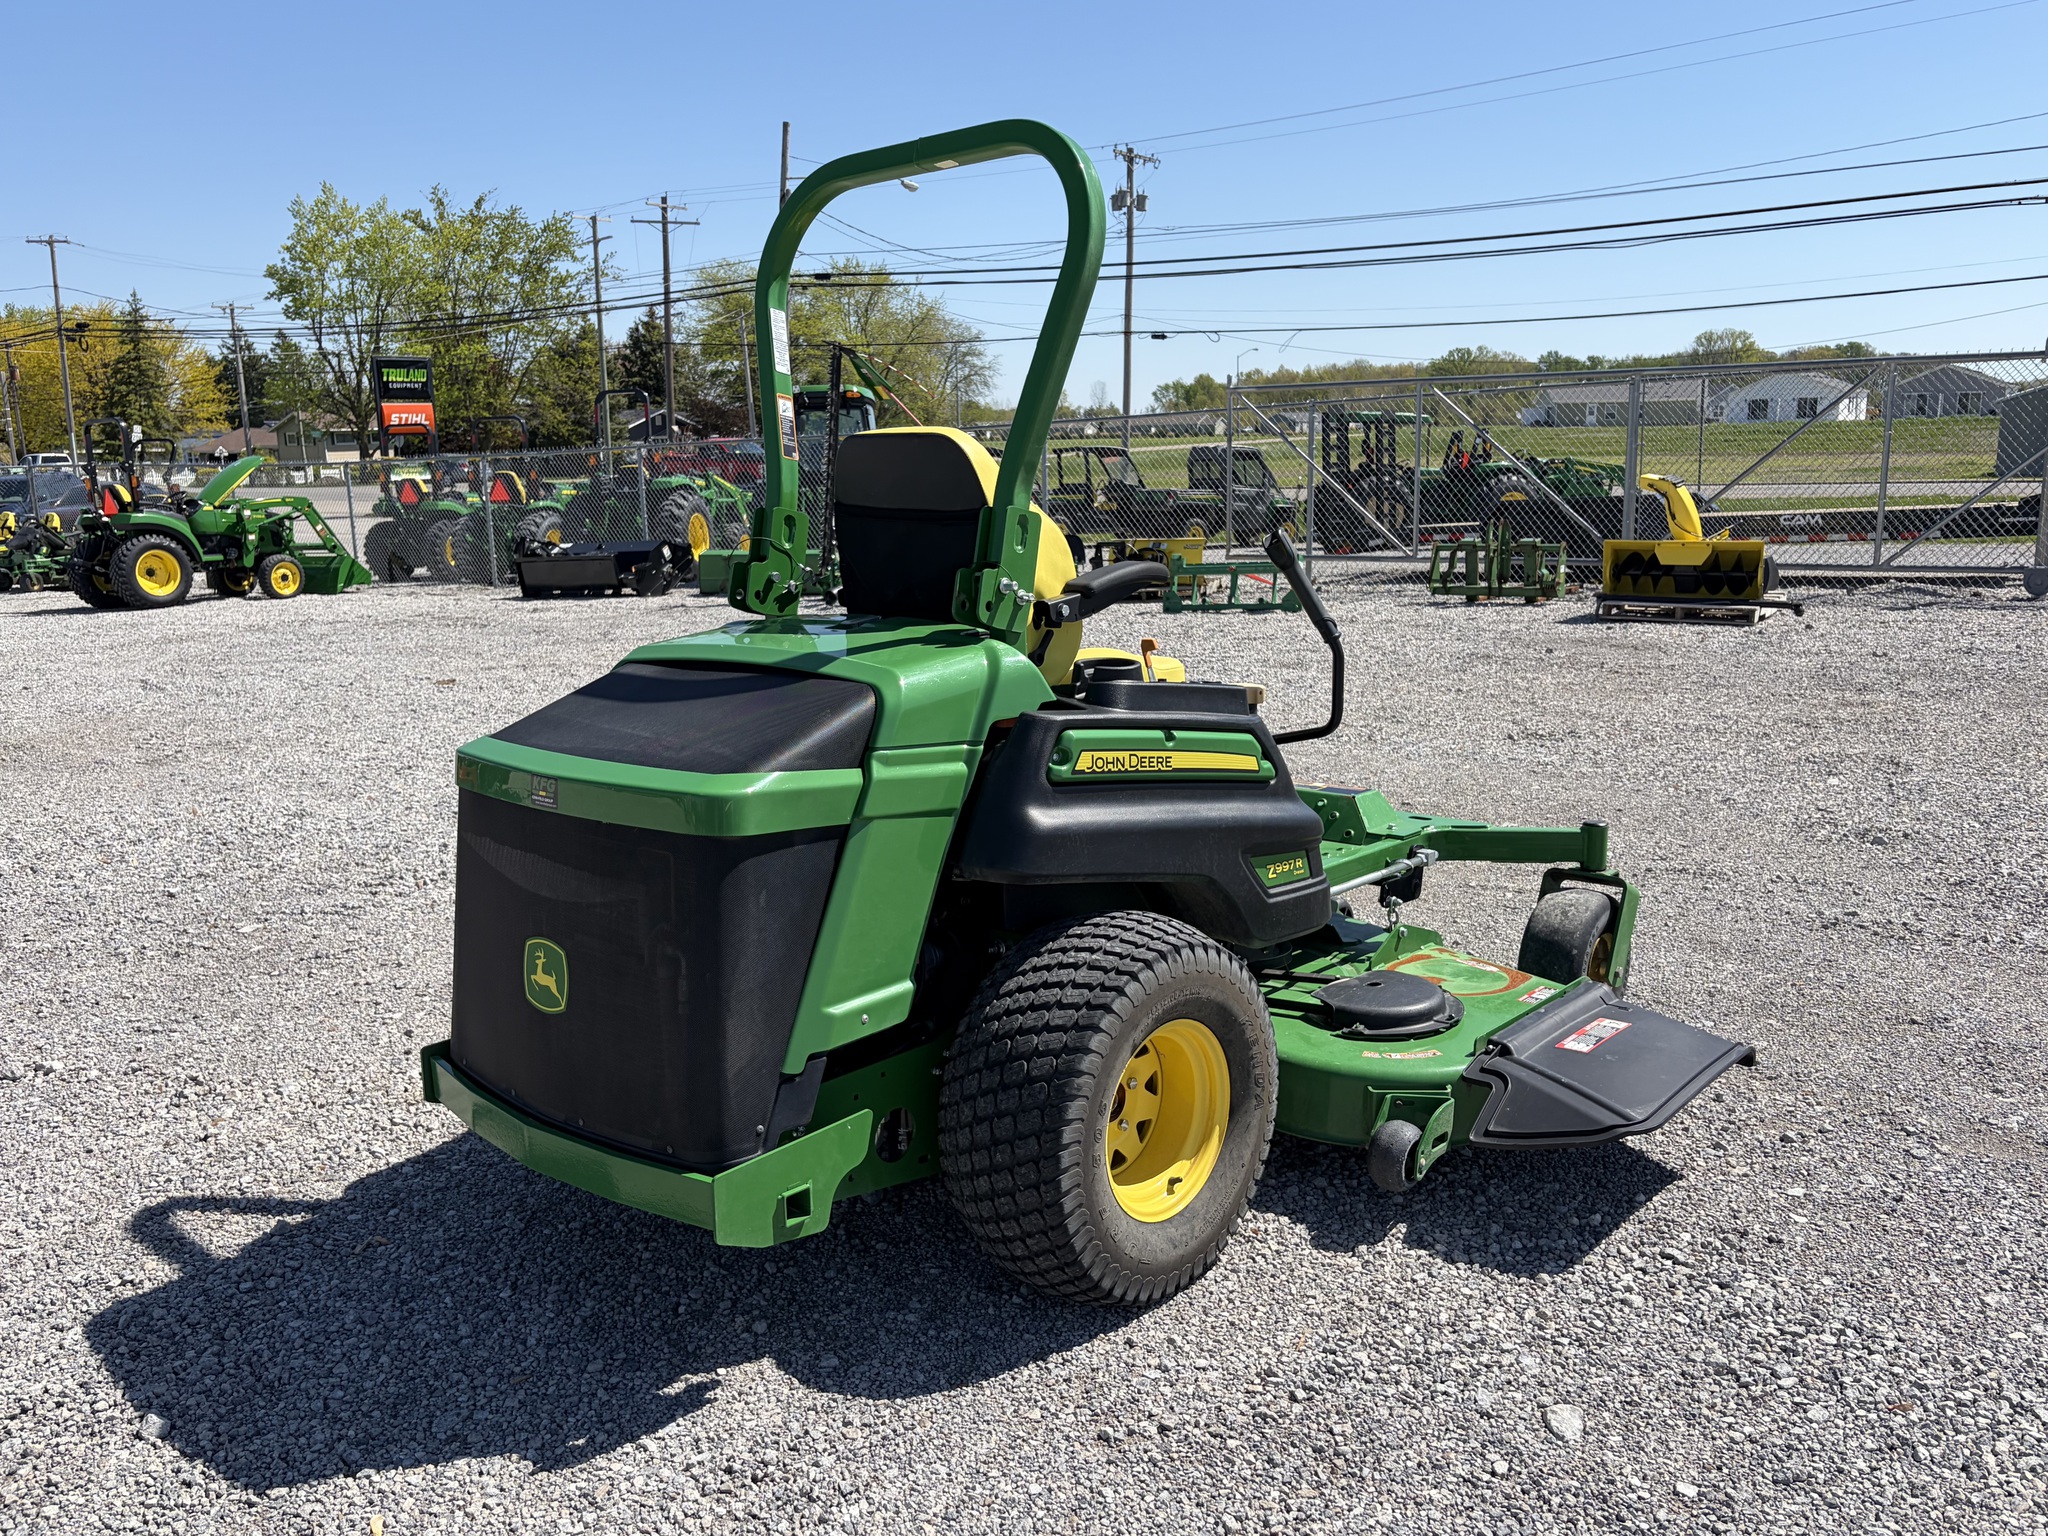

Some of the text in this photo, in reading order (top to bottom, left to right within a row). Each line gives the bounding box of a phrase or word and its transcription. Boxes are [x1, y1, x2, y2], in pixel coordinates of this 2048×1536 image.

[381, 368, 427, 382] TRULAND
[389, 413, 430, 425] STIHL
[1780, 514, 1822, 526] CAM
[1086, 753, 1173, 770] JOHN DEERE
[532, 775, 556, 792] KFG
[1240, 1013, 1264, 1110] KENDA
